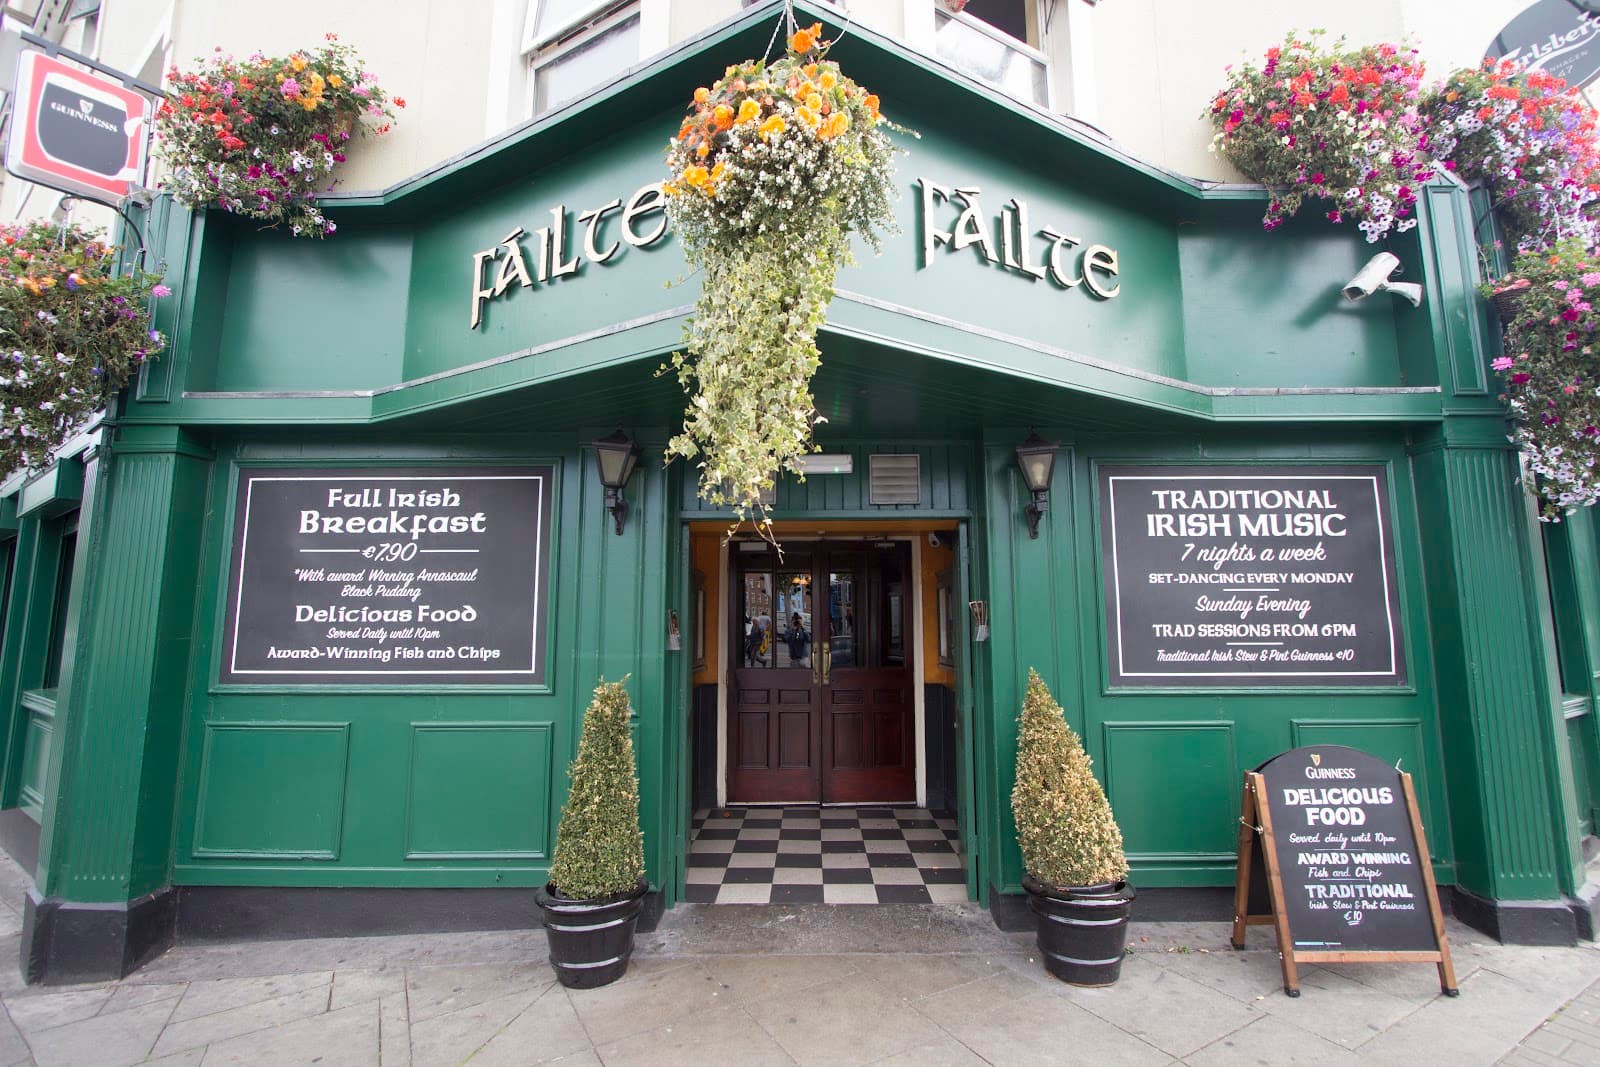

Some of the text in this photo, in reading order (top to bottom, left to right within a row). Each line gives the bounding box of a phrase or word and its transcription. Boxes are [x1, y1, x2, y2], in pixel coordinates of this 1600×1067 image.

[50, 102, 118, 132] GUINNESS
[328, 488, 460, 507] Full Irish
[1152, 490, 1337, 509] TRADITIONAL
[299, 510, 486, 540] Breakfast
[1147, 513, 1346, 536] IRISH MUSIC
[362, 543, 417, 561] €7.90
[1181, 542, 1326, 570] 7 nights a week
[327, 569, 365, 581] award
[369, 569, 414, 587] Winning
[417, 569, 478, 581] Annascaul
[1149, 573, 1353, 583] SET-DANCING EVERY MONDAY
[341, 584, 421, 602] Black Pudding
[296, 605, 477, 622] Delicious Food
[1195, 595, 1311, 619] Sunday Evening
[326, 627, 440, 644] Served Daily until 10pm
[1152, 624, 1356, 637] TRAD SESSIONS FROM 6PM
[267, 647, 500, 662] Award-Winning Fish and Chips
[1157, 650, 1210, 661] Traditional
[1211, 649, 1233, 661] Irish
[1235, 649, 1258, 661] Stew
[1260, 650, 1268, 661] &
[1267, 649, 1289, 661] Pint
[1291, 649, 1334, 661] Guinness
[1305, 767, 1355, 779] GUINNESS
[1283, 787, 1393, 805] DELICIOUS
[1306, 807, 1365, 825] FOOD
[1289, 832, 1396, 850] Served daily until 10pm
[1298, 853, 1411, 864] AWARD WINNING
[1309, 867, 1382, 882] Fish and Chips
[1304, 884, 1413, 899] TRADITIONAL
[1309, 900, 1414, 909] Irish Stew & Pint Guinness
